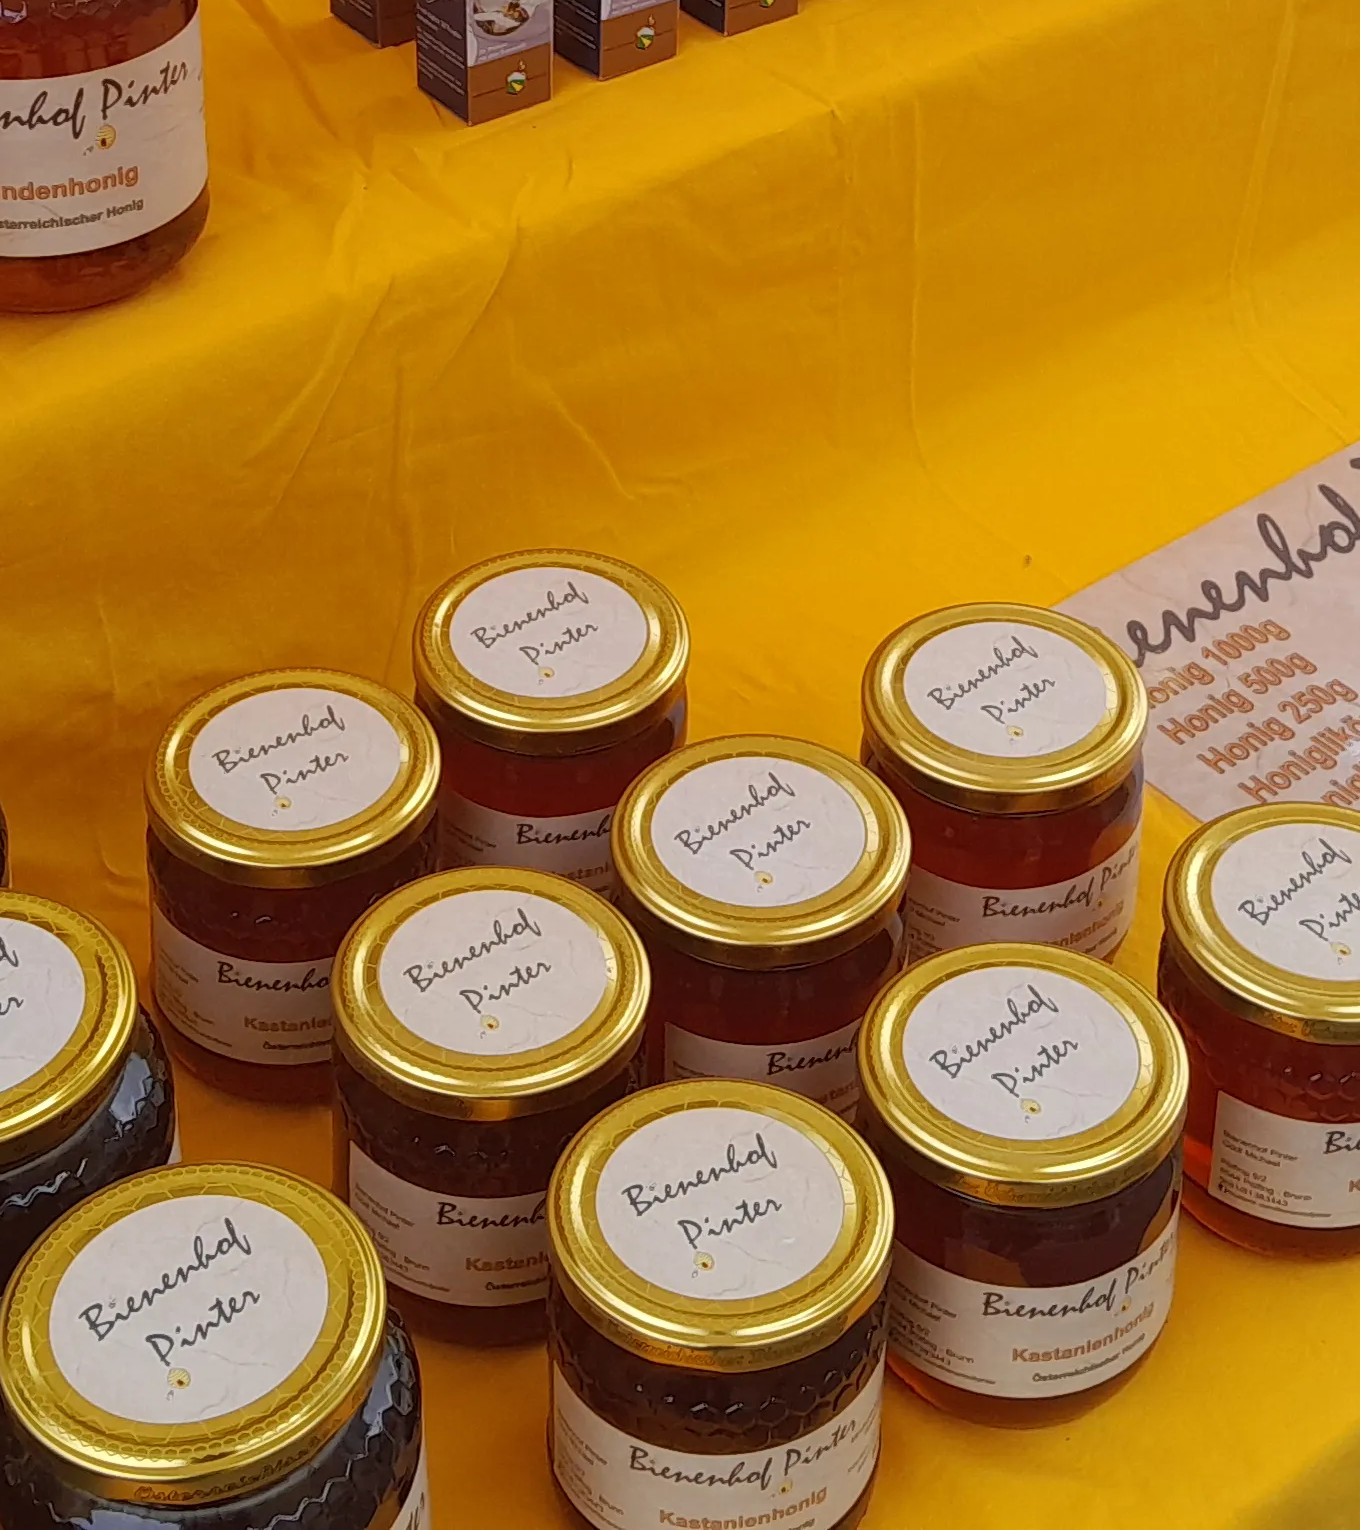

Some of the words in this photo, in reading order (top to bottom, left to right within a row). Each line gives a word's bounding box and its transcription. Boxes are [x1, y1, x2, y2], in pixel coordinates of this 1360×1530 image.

[100, 61, 190, 125] Pinter
[105, 197, 144, 219] Honig
[470, 581, 590, 649] Bienenhof
[519, 623, 599, 666] Pinter
[927, 636, 1039, 711] Bienenhof
[1148, 661, 1215, 710] onig
[1201, 619, 1291, 666] 1000g
[981, 677, 1056, 725] Pinter
[1157, 689, 1255, 746] Honig
[1238, 652, 1318, 694] 500g
[1196, 716, 1296, 774] Honig
[1278, 679, 1359, 724] 250g
[212, 704, 347, 775] Bienenhof
[260, 750, 349, 795] Pinter
[674, 772, 796, 855] Bienenhof
[730, 818, 811, 870] Pinter
[982, 876, 1095, 920] Bienenhof
[1237, 837, 1353, 927] Bienenhof
[216, 959, 332, 994] Bienenho
[403, 907, 543, 993] Bienenhof
[459, 959, 553, 1015] Pinter
[929, 985, 1059, 1079] Bienenhof
[991, 1037, 1079, 1098] Pinter
[621, 1133, 778, 1217] Bienenhof
[677, 1195, 782, 1249] Pinter
[78, 1217, 252, 1341] Bienenhof
[982, 1278, 1116, 1319] Bienenhof
[145, 1288, 261, 1367] Pinter
[1012, 1302, 1154, 1363] Kastanienhonig
[629, 1444, 773, 1491] Bienenhof
[783, 1419, 857, 1477] Pinter
